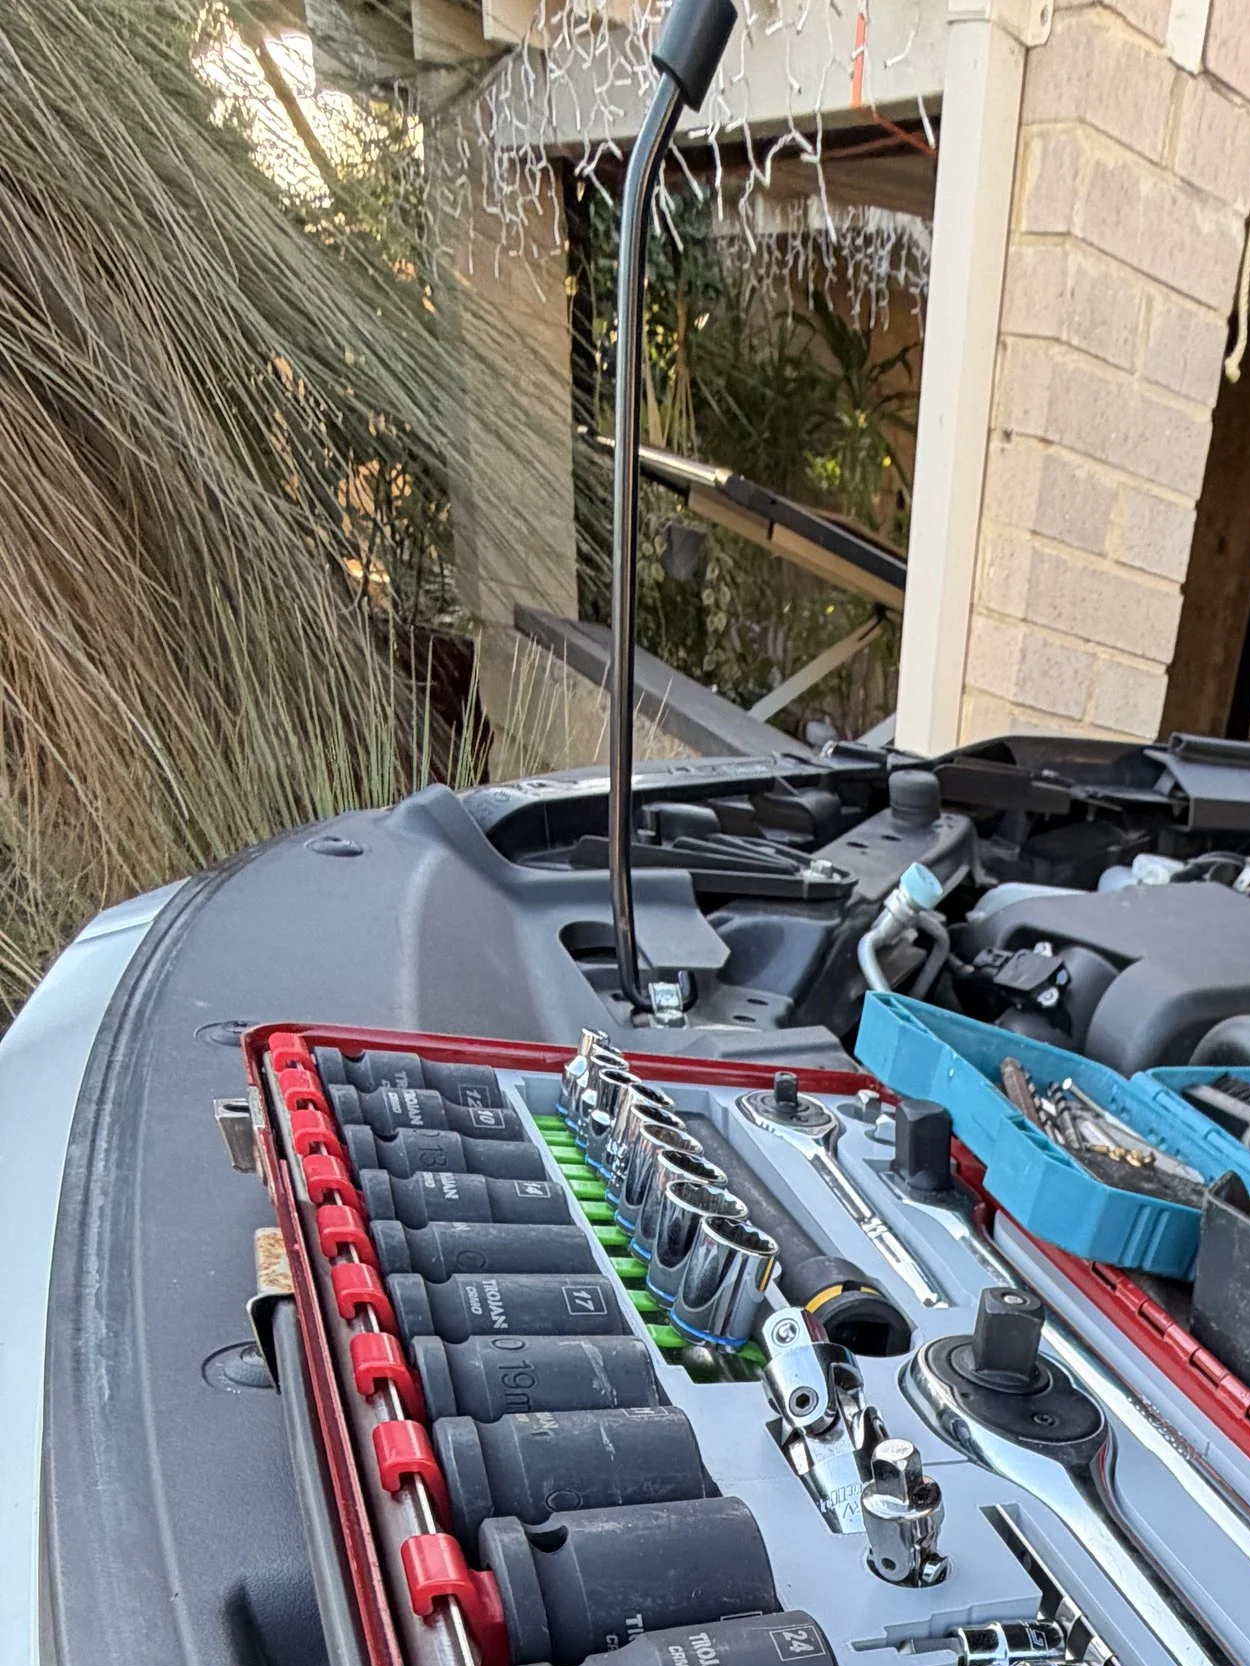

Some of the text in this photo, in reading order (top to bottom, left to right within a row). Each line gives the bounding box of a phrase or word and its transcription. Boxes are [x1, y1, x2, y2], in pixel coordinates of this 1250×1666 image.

[477, 1109, 497, 1126] 10
[465, 1286, 483, 1316] CRMO
[482, 1279, 509, 1330] TROJAN
[571, 1290, 596, 1312] 17
[781, 1629, 816, 1654] 24
